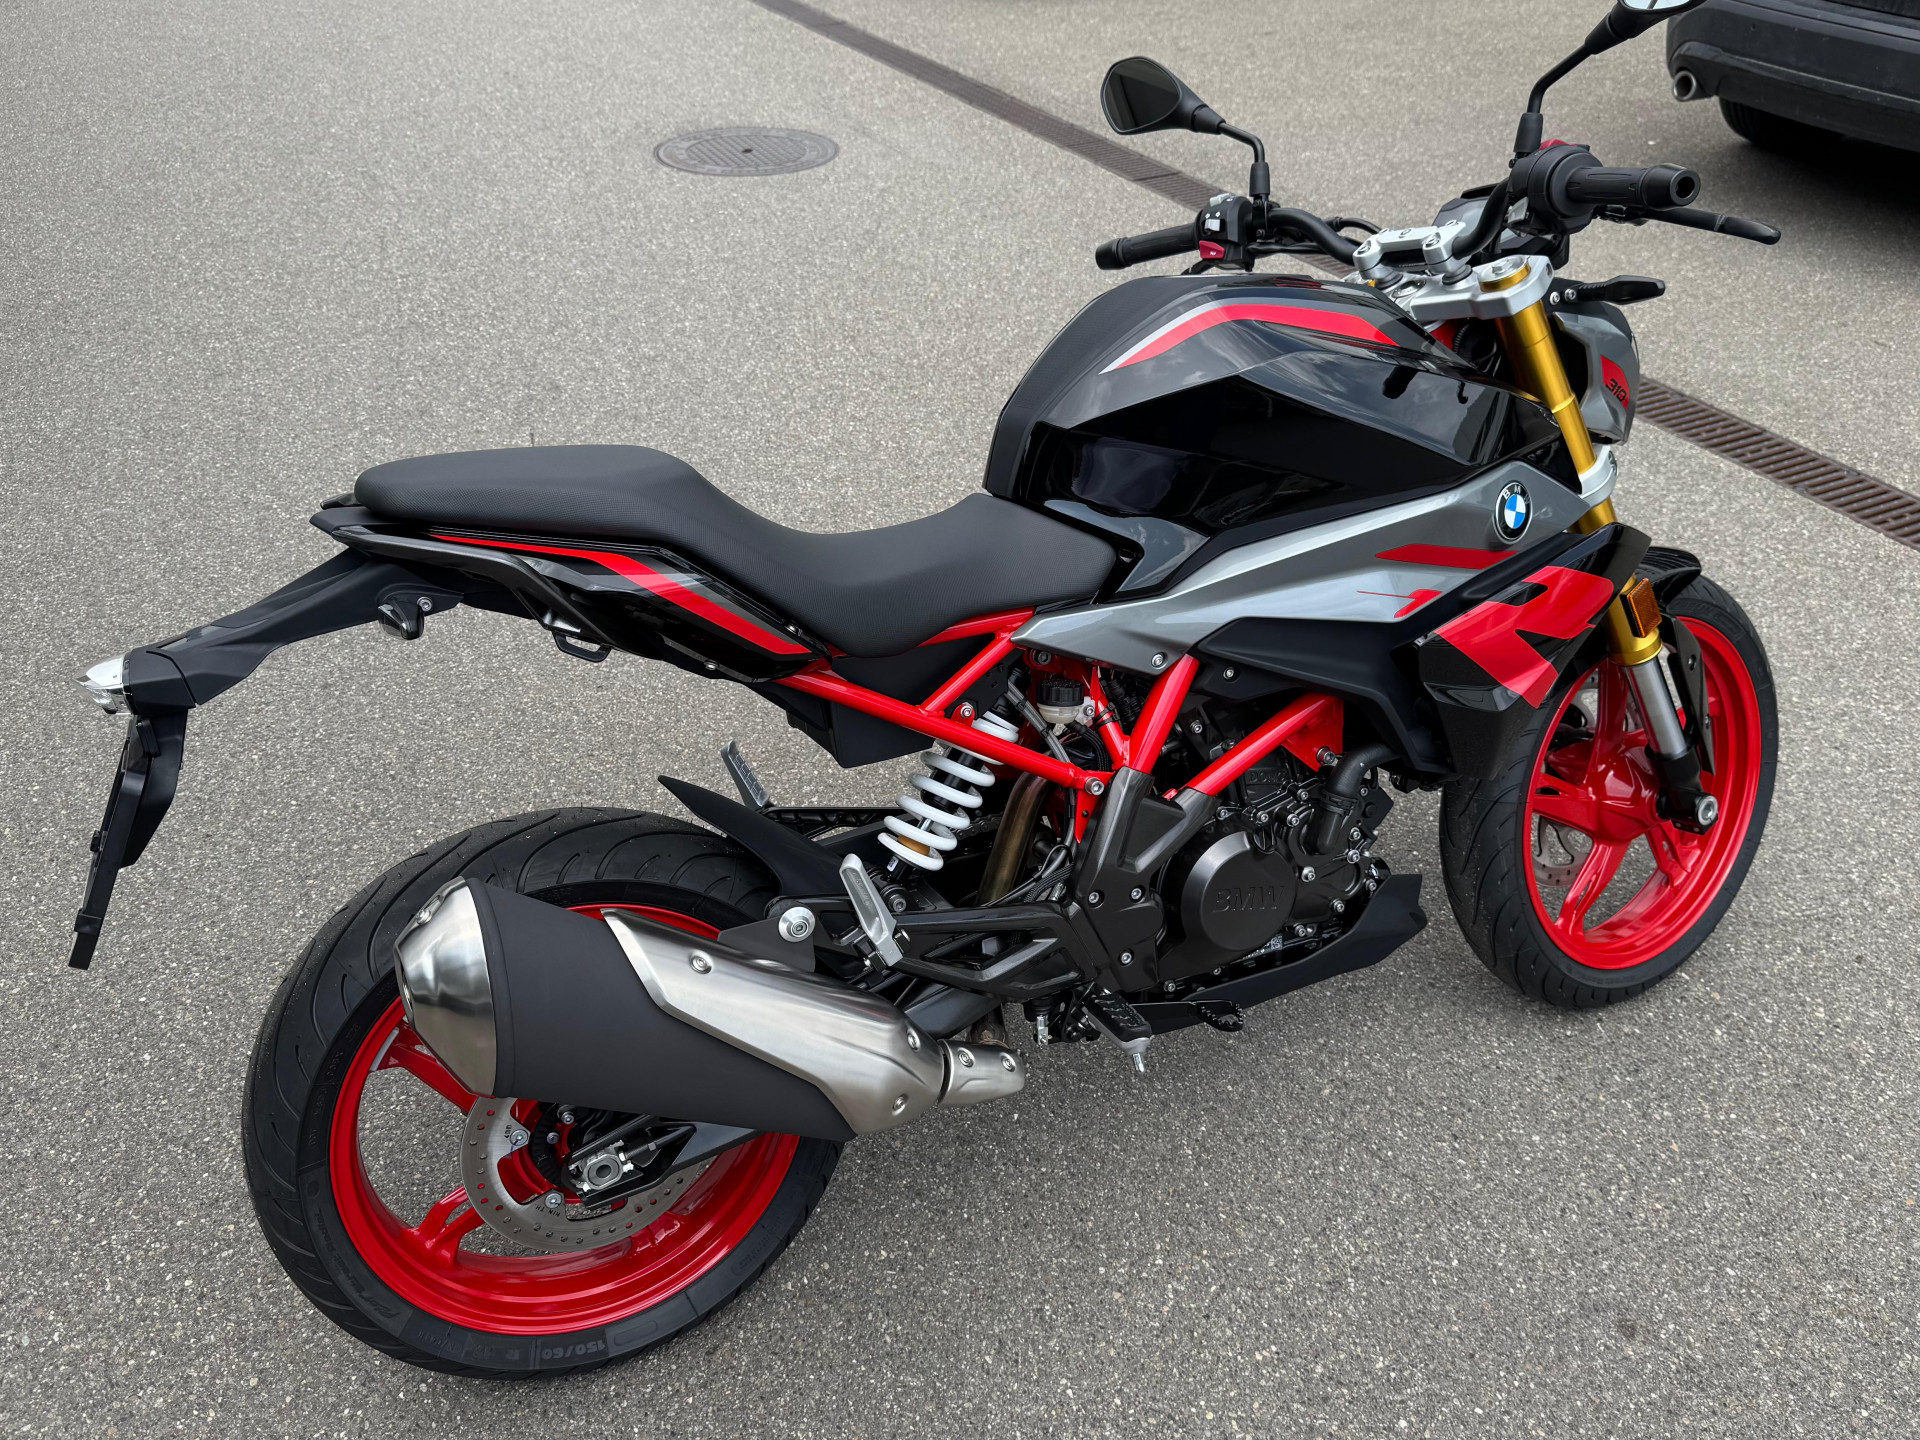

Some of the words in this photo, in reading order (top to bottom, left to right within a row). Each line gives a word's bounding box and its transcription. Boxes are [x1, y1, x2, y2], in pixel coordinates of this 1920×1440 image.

[1605, 378, 1627, 402] 310
[1501, 485, 1530, 505] BMW
[1212, 885, 1286, 912] BMW
[541, 1339, 606, 1361] 150/60
